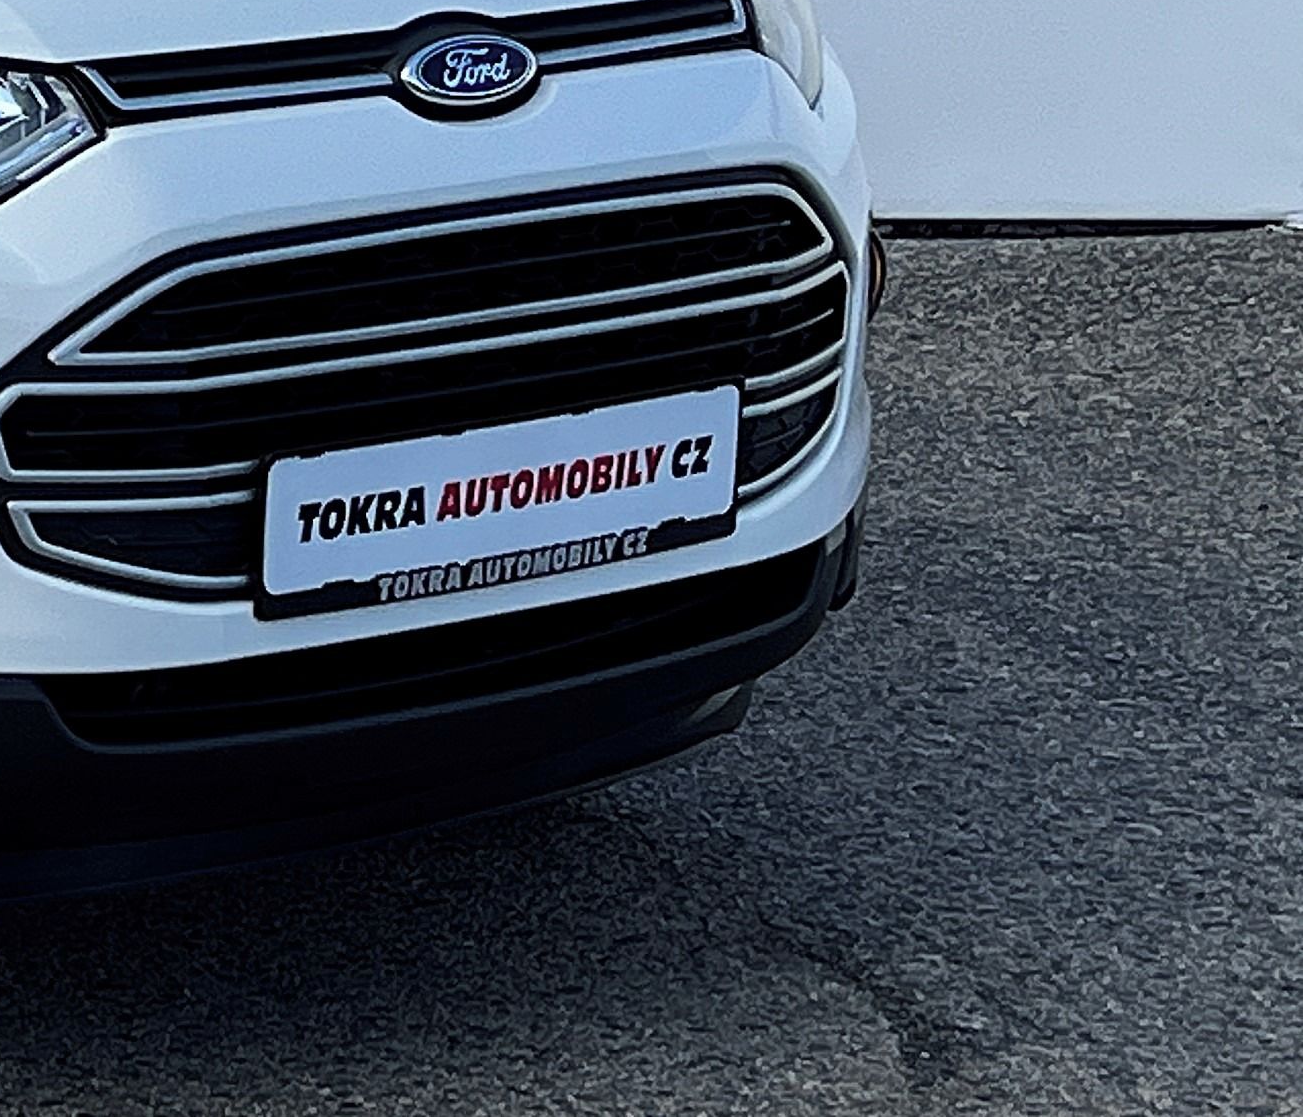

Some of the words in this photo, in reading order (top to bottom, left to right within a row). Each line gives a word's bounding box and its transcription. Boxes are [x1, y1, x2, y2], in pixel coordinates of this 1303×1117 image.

[443, 47, 511, 88] Ford
[297, 485, 427, 544] TOKRA
[435, 443, 667, 523] AUTOMOBILY
[670, 433, 714, 479] CZ
[377, 566, 462, 602] TOKRA
[466, 534, 617, 588] AUTOMOBILY
[621, 528, 648, 555] CZ
